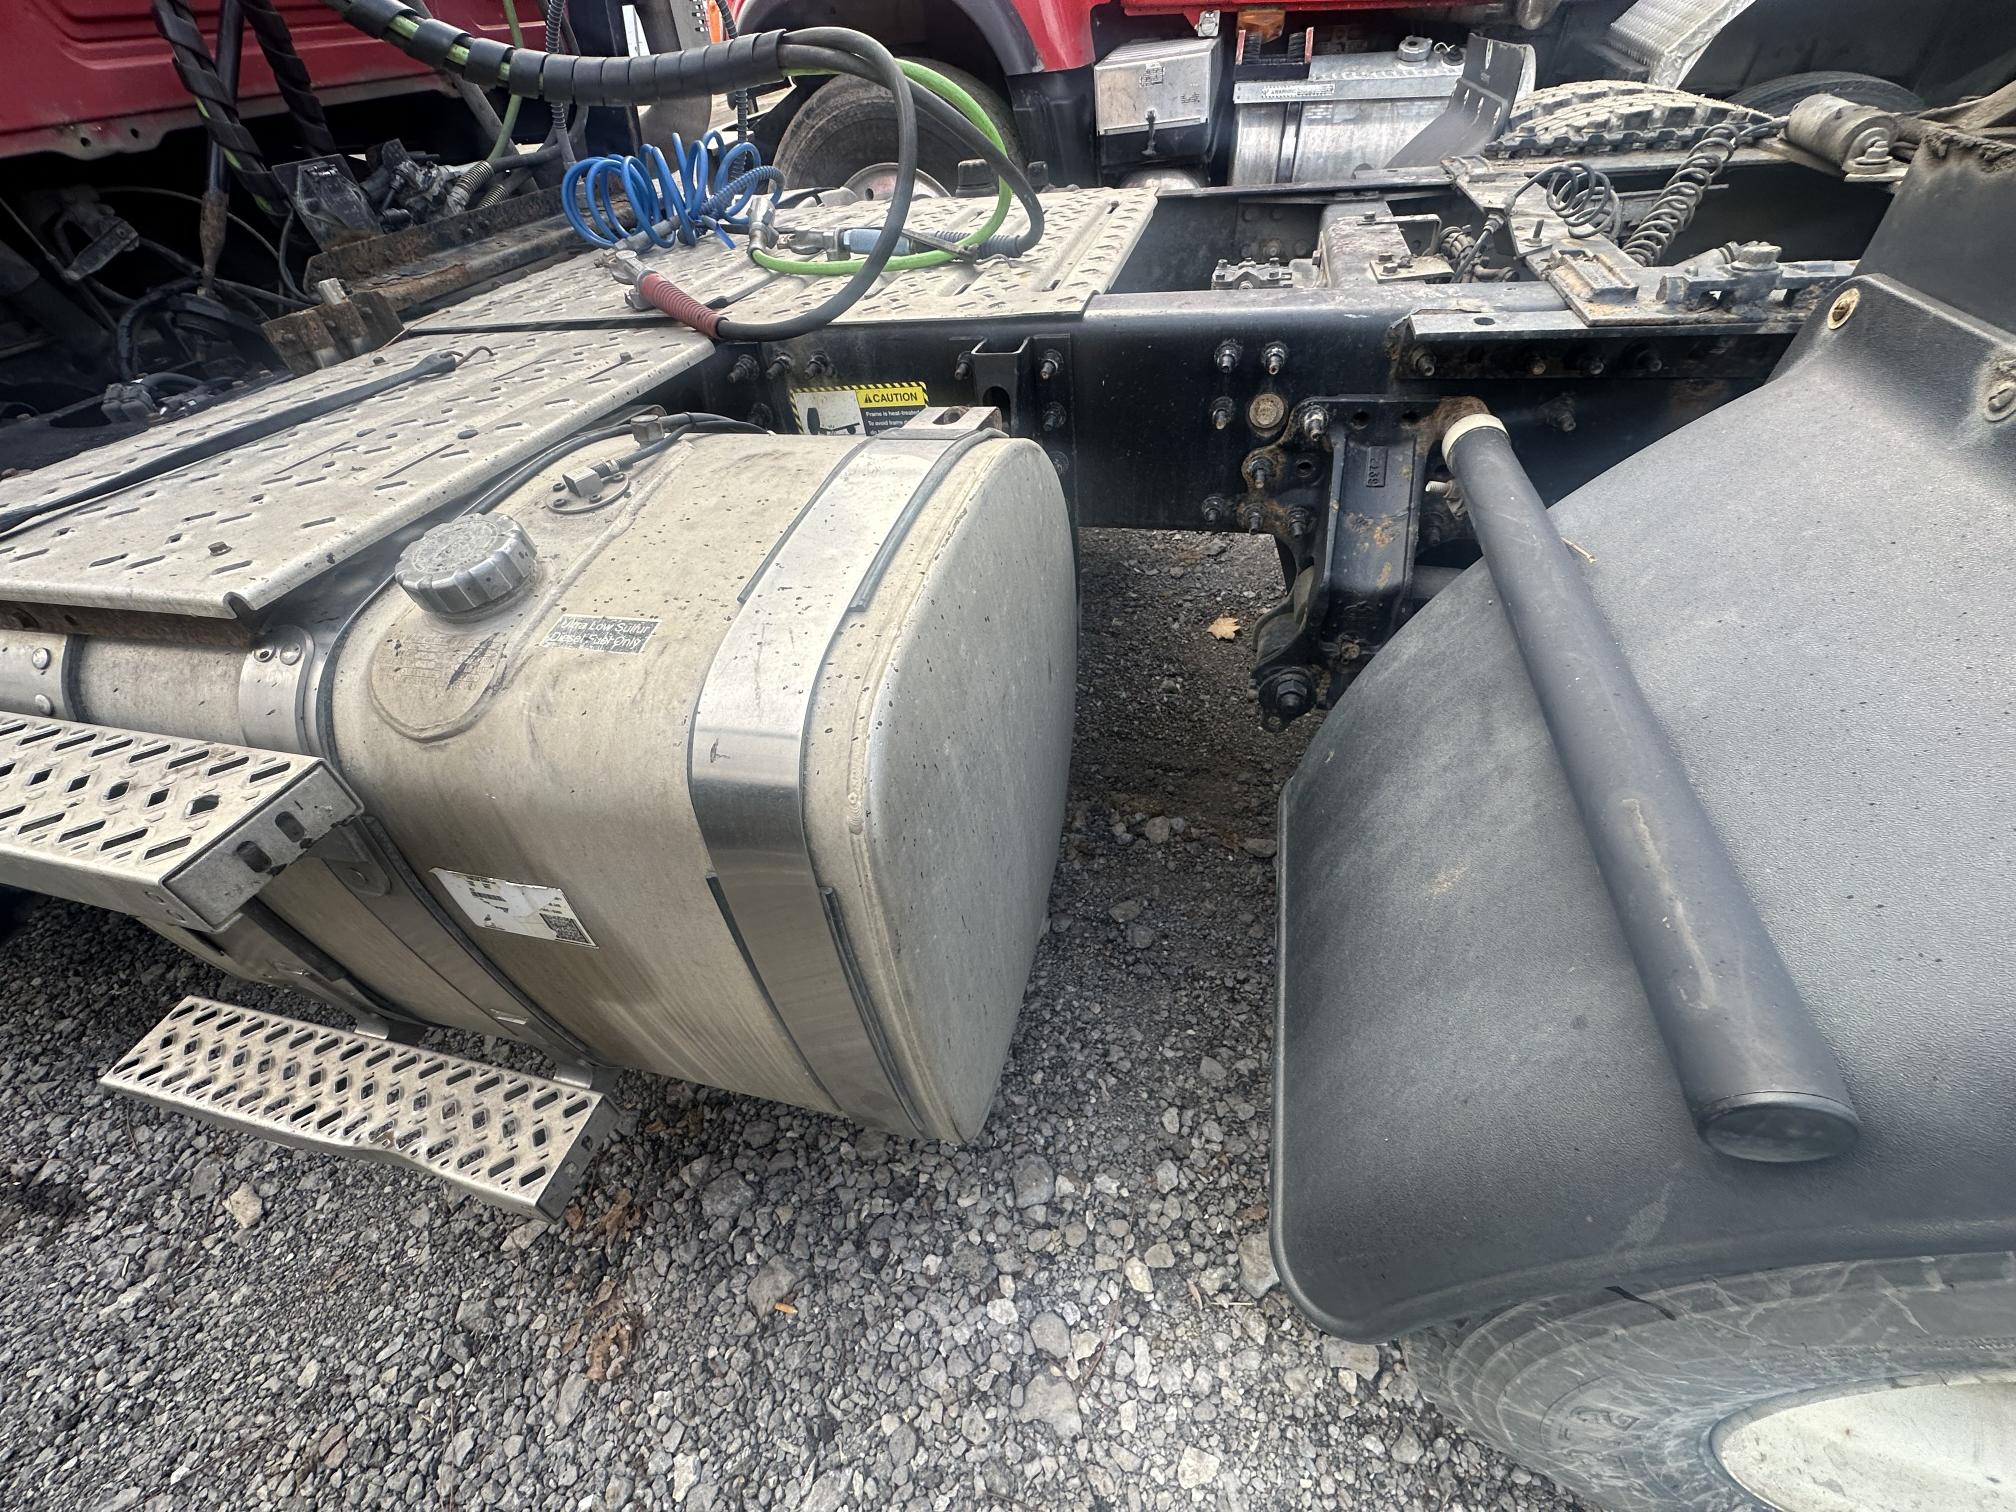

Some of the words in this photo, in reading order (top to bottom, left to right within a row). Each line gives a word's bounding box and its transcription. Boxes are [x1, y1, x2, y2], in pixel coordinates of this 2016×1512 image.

[873, 392, 917, 403] CAUTION
[561, 618, 588, 629] Ultra
[589, 622, 614, 631] Low
[615, 622, 651, 634] Sulfur
[551, 632, 585, 643] Diesel
[614, 636, 642, 649] Only
